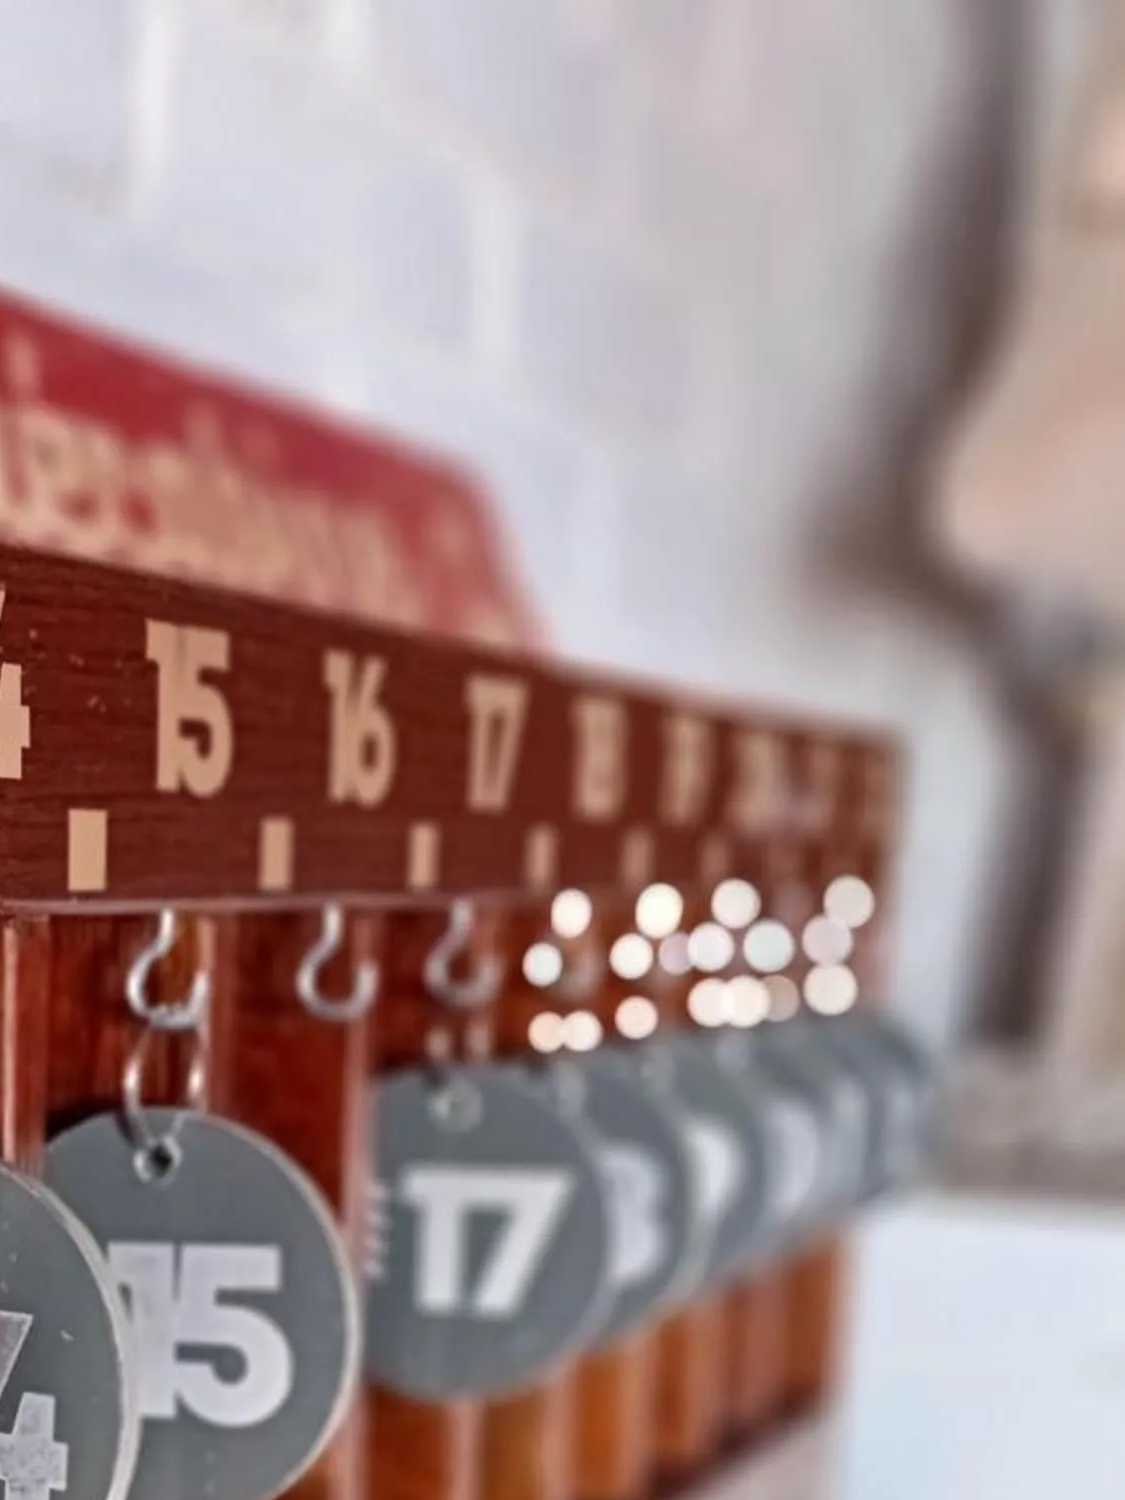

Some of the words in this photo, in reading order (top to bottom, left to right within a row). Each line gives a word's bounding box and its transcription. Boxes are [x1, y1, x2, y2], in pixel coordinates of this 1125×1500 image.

[145, 618, 234, 798] 15
[322, 647, 397, 809] 16
[464, 672, 529, 815] 17
[397, 1163, 571, 1316] 17
[107, 1241, 295, 1429] 15
